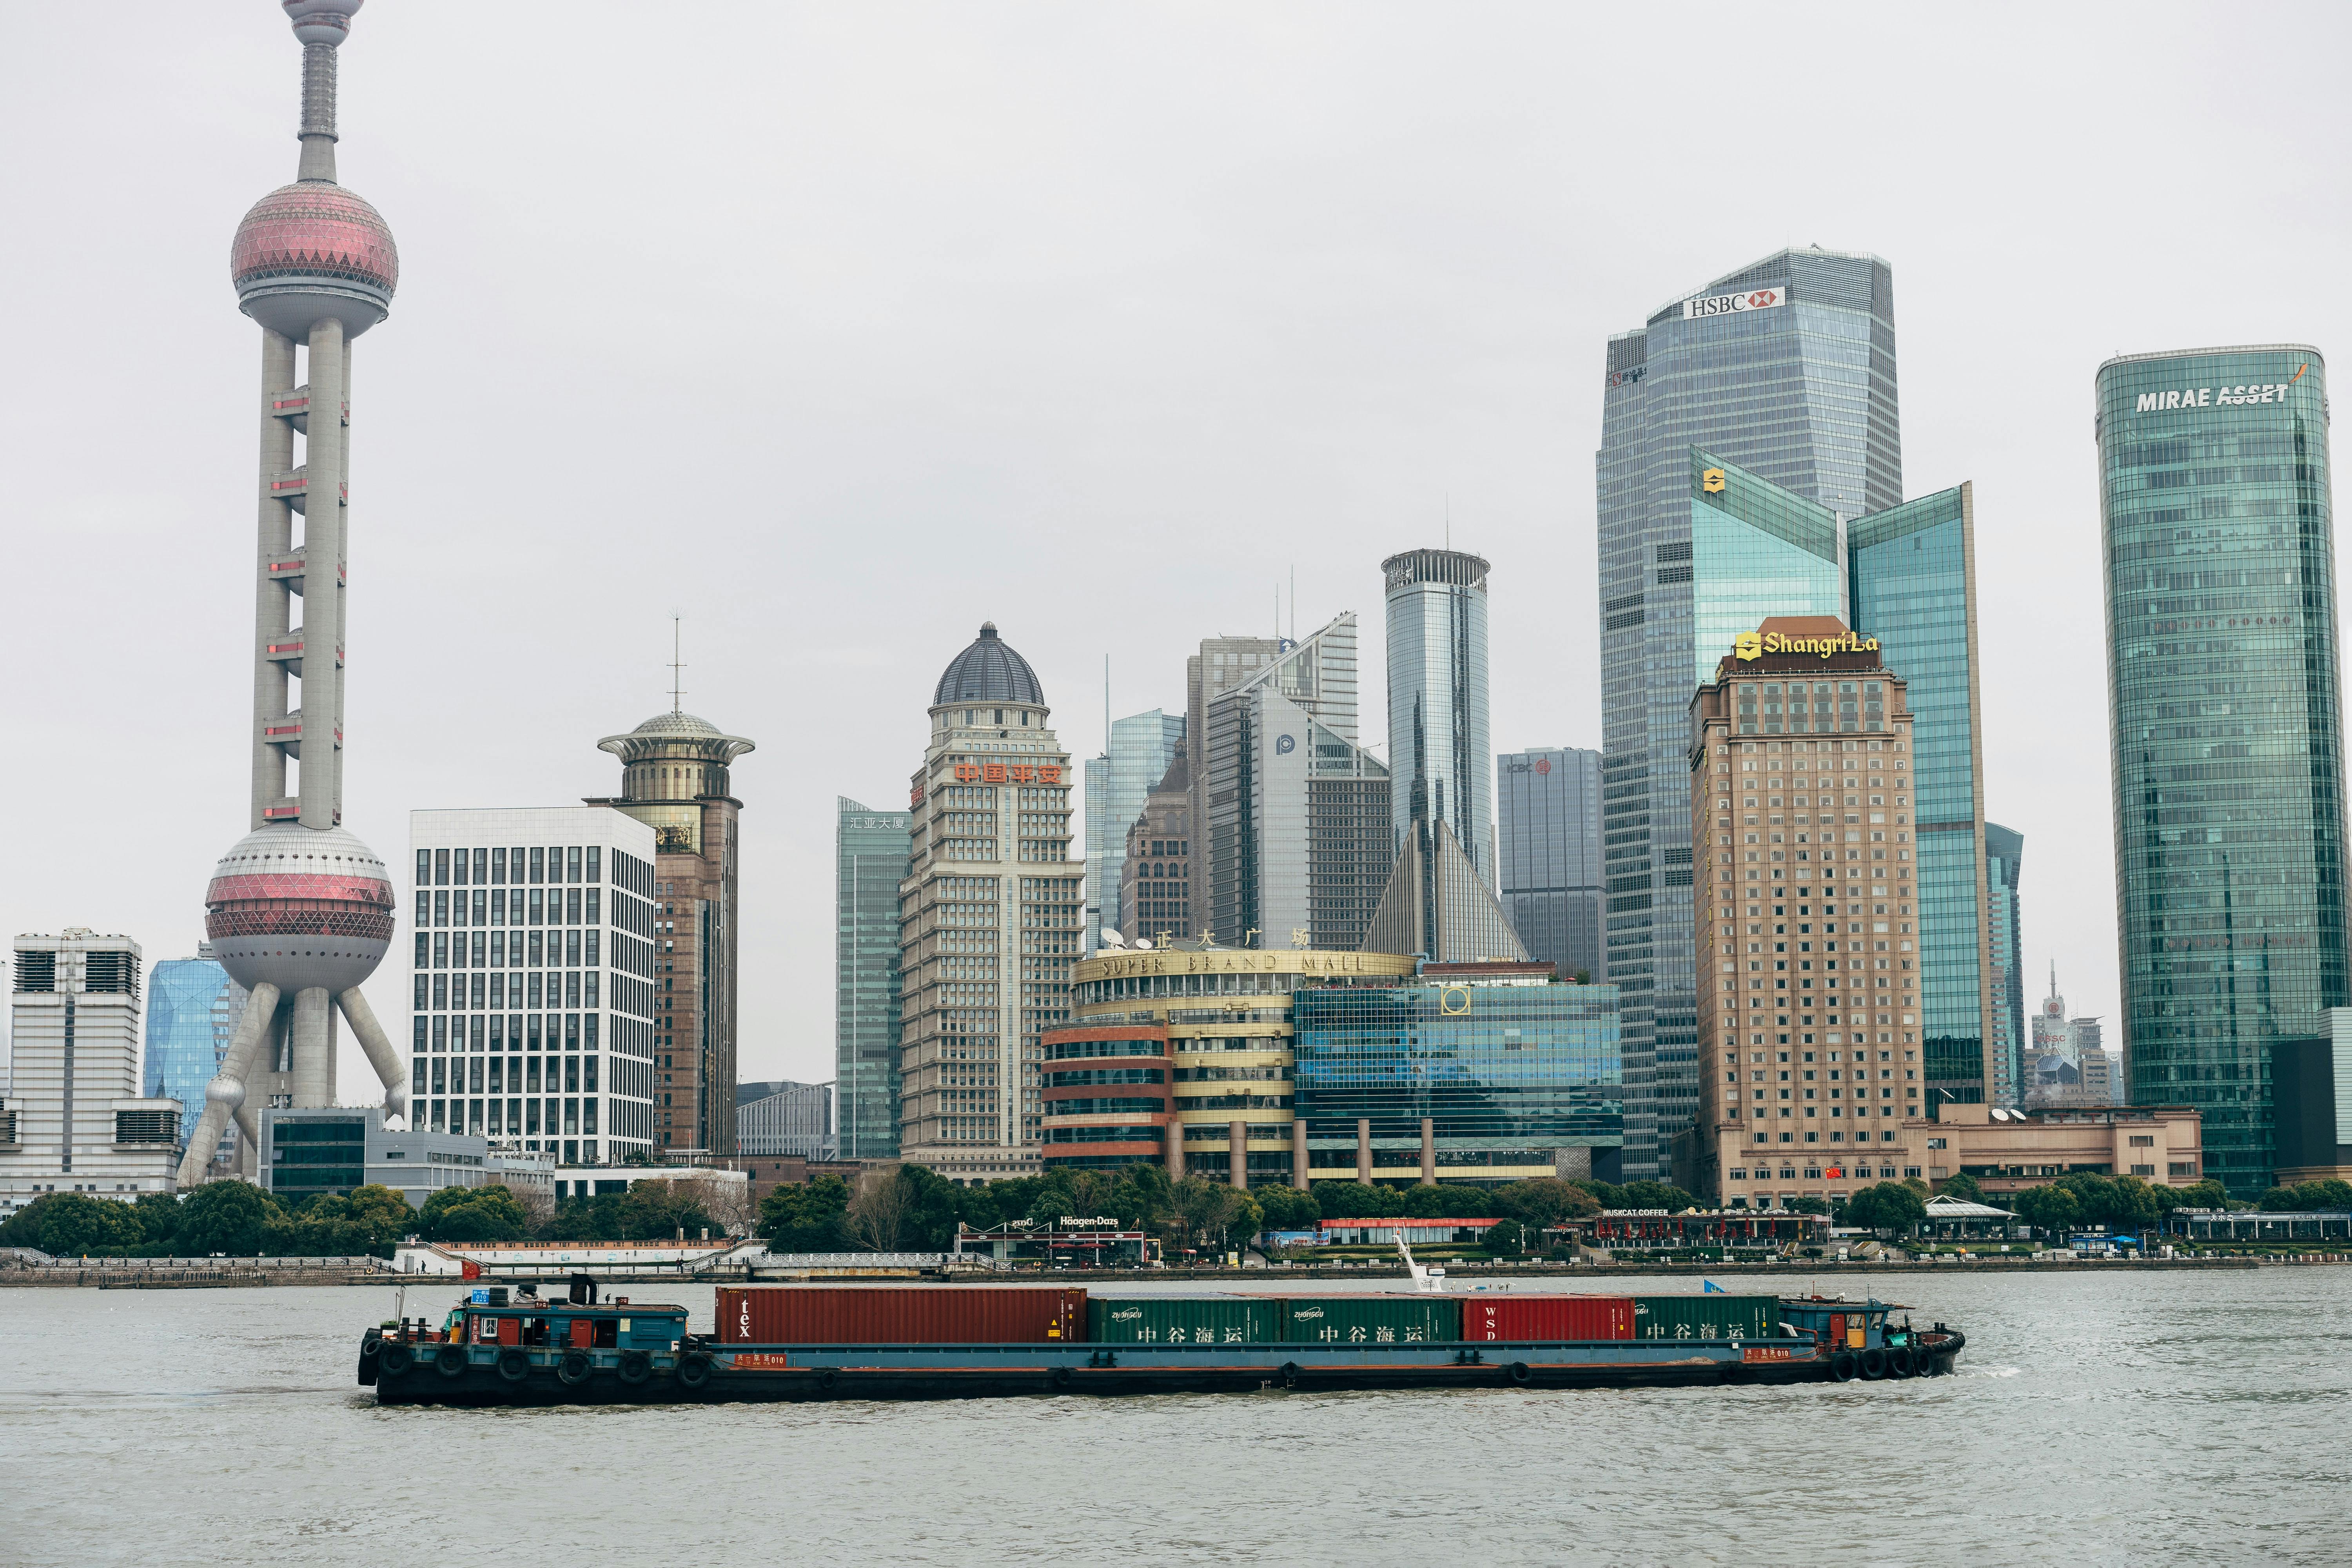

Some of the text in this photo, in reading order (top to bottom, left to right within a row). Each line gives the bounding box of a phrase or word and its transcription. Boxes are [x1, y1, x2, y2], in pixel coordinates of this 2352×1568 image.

[1691, 294, 1746, 317] HSBC
[2136, 383, 2289, 413] MIRAE ASSET
[1763, 631, 1878, 659] Shangri-La
[955, 763, 1062, 784] 中国平安
[1507, 763, 1532, 773] ICBC
[850, 817, 905, 829] 汇亚大厦
[1155, 928, 1310, 949] 正大广场
[1102, 955, 1365, 975] SUPER BRAND MALL
[1060, 1216, 1118, 1227] Häagen-Dazs
[739, 1299, 750, 1337] tex
[1485, 1307, 1496, 1340] WSD
[1138, 1327, 1242, 1343] 中谷海运
[1320, 1326, 1423, 1342] 中谷海运
[1648, 1323, 1745, 1339] 中谷海运
